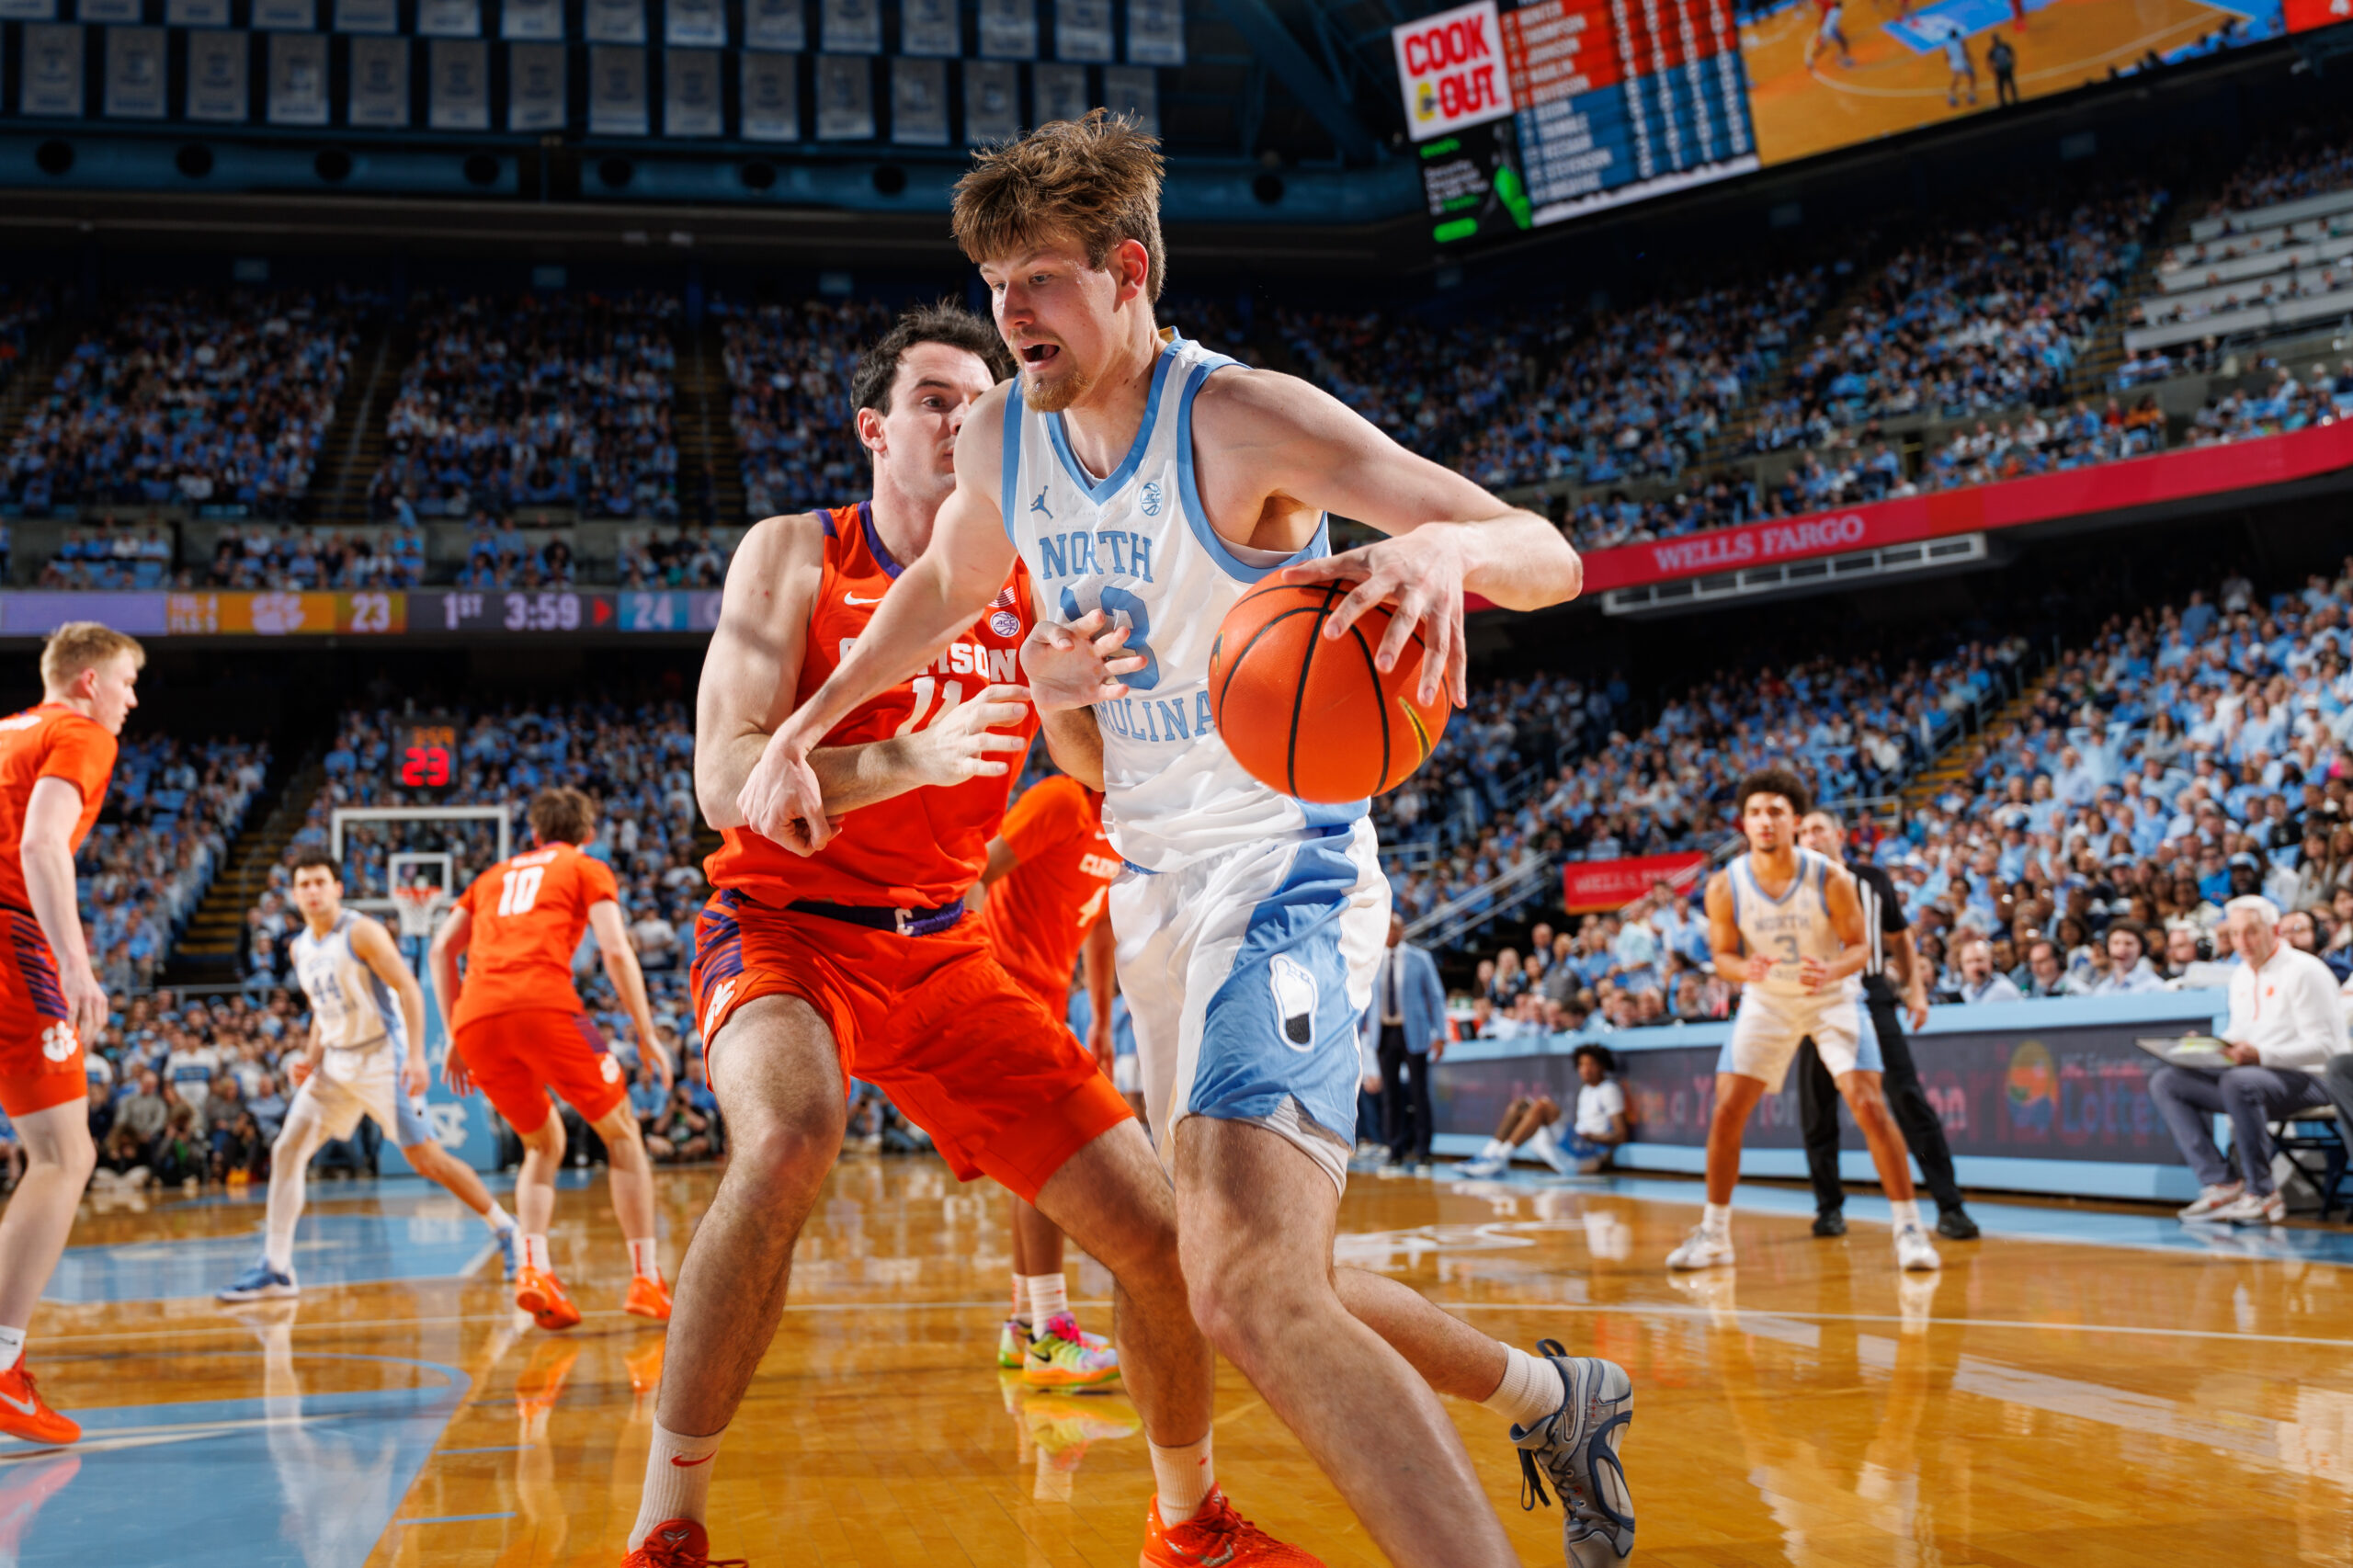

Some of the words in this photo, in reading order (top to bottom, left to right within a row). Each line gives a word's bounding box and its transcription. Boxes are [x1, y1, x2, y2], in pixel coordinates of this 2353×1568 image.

[1404, 12, 1490, 78] COOK
[1439, 63, 1494, 119] OUT
[1039, 530, 1154, 583] NORTH
[1654, 536, 1754, 572] WELLS
[1761, 515, 1865, 556] FARGO
[350, 593, 391, 631] 23
[443, 593, 483, 630] 1ST
[505, 593, 581, 631] 3:59
[634, 594, 673, 631] 24
[402, 747, 450, 787] 23
[497, 865, 545, 916] 10
[894, 907, 915, 936] C
[1774, 935, 1800, 966] 3
[313, 972, 341, 1004] 44
